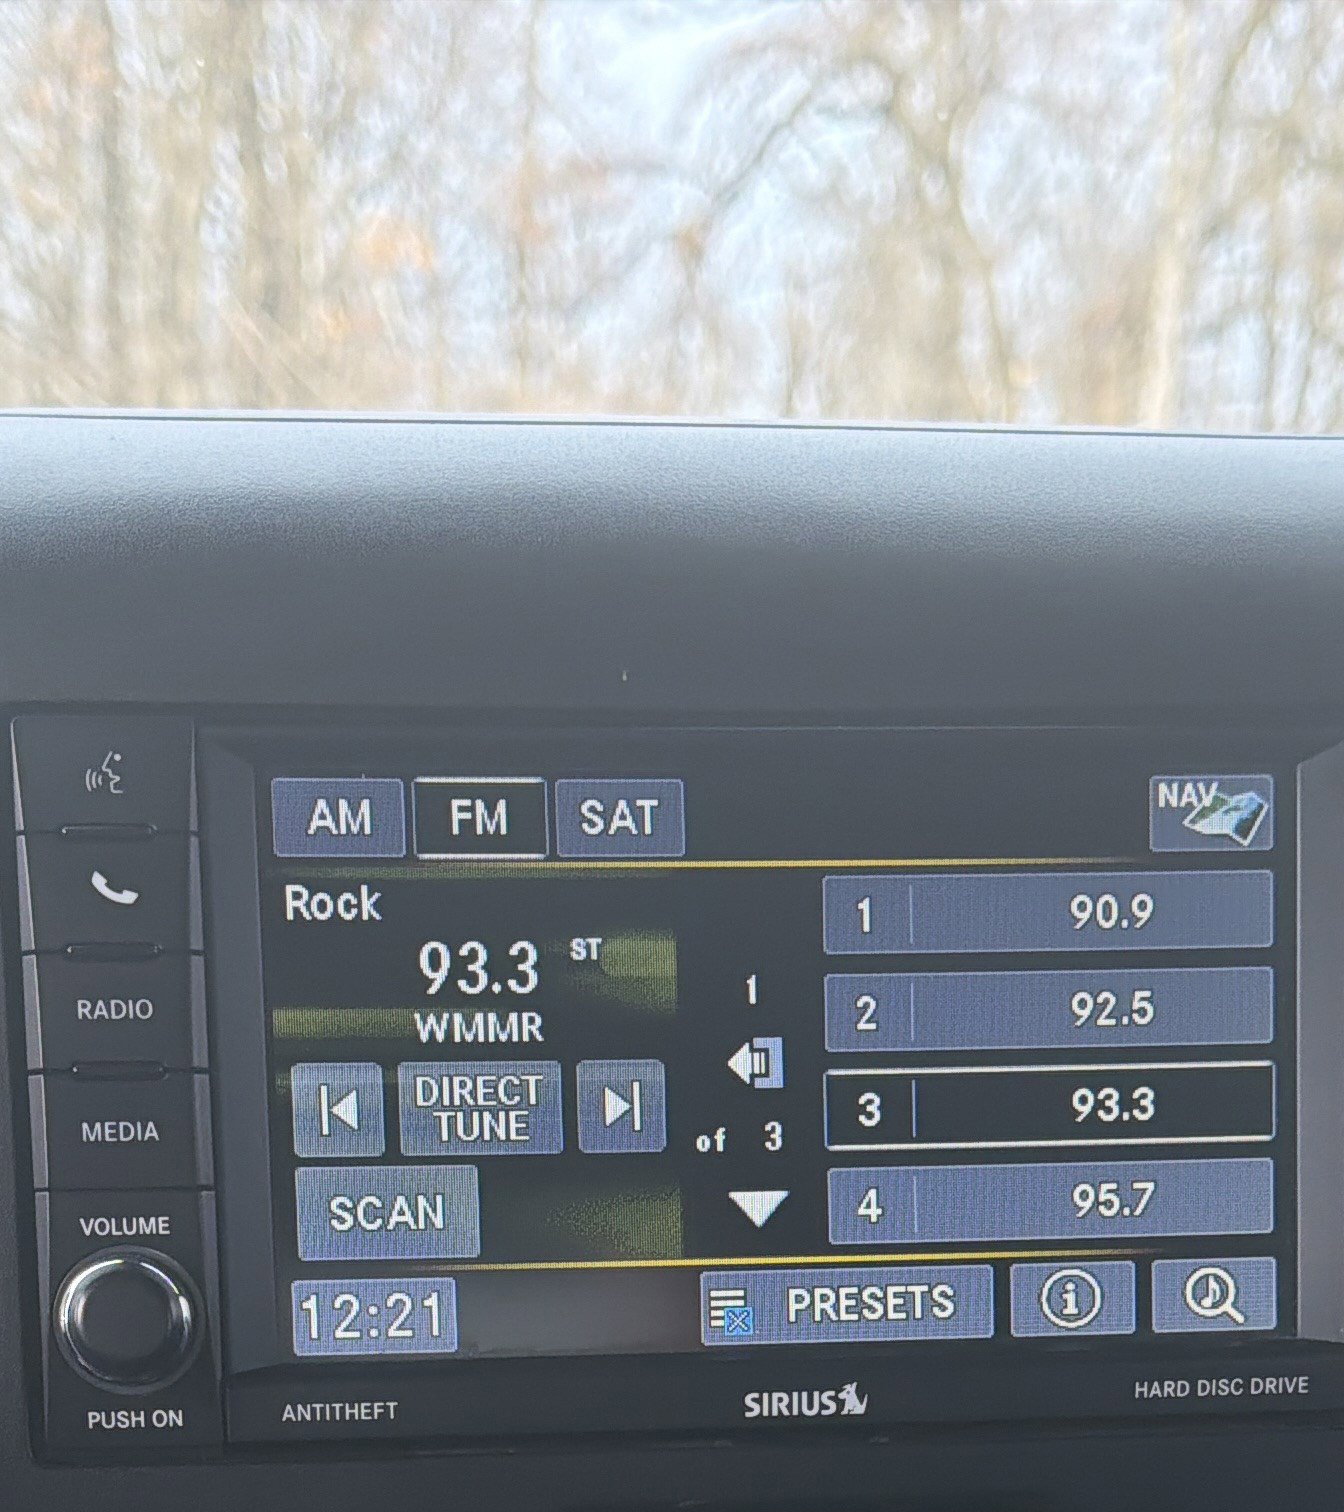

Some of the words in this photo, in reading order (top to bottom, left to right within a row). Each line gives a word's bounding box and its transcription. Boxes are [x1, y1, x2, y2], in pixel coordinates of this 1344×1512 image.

[1157, 780, 1218, 808] NAV
[307, 798, 371, 835] AM
[450, 798, 507, 835] FM
[580, 799, 659, 835] SAT
[285, 884, 382, 921] Rock
[857, 897, 870, 933] 1
[1070, 893, 1154, 930] 90.9
[570, 937, 603, 961] ST
[419, 940, 538, 995] 93.3
[746, 974, 757, 1005] 1
[77, 998, 154, 1020] RADIO
[856, 995, 877, 1030] 2
[1071, 990, 1154, 1026] 92.5
[413, 1011, 544, 1043] WMMR
[415, 1074, 544, 1108] DIRECT
[858, 1092, 881, 1127] 3
[1072, 1086, 1155, 1123] 93.3
[81, 1121, 160, 1142] MEDIA
[434, 1110, 530, 1142] TUNE
[696, 1127, 726, 1153] of
[764, 1121, 783, 1151] 3
[330, 1194, 444, 1231] SCAN
[857, 1188, 883, 1223] 4
[1072, 1181, 1155, 1218] 95.7
[79, 1216, 170, 1237] VOLUME
[300, 1292, 440, 1340] 12:21
[788, 1284, 955, 1323] PRESETS
[744, 1390, 836, 1418] SIRIUS
[1134, 1380, 1190, 1399] HARD
[1197, 1377, 1244, 1397] DISC
[1250, 1376, 1309, 1395] DRIVE
[87, 1410, 145, 1429] PUSH
[151, 1409, 183, 1428] ON
[282, 1401, 398, 1422] ANTITHEFT
